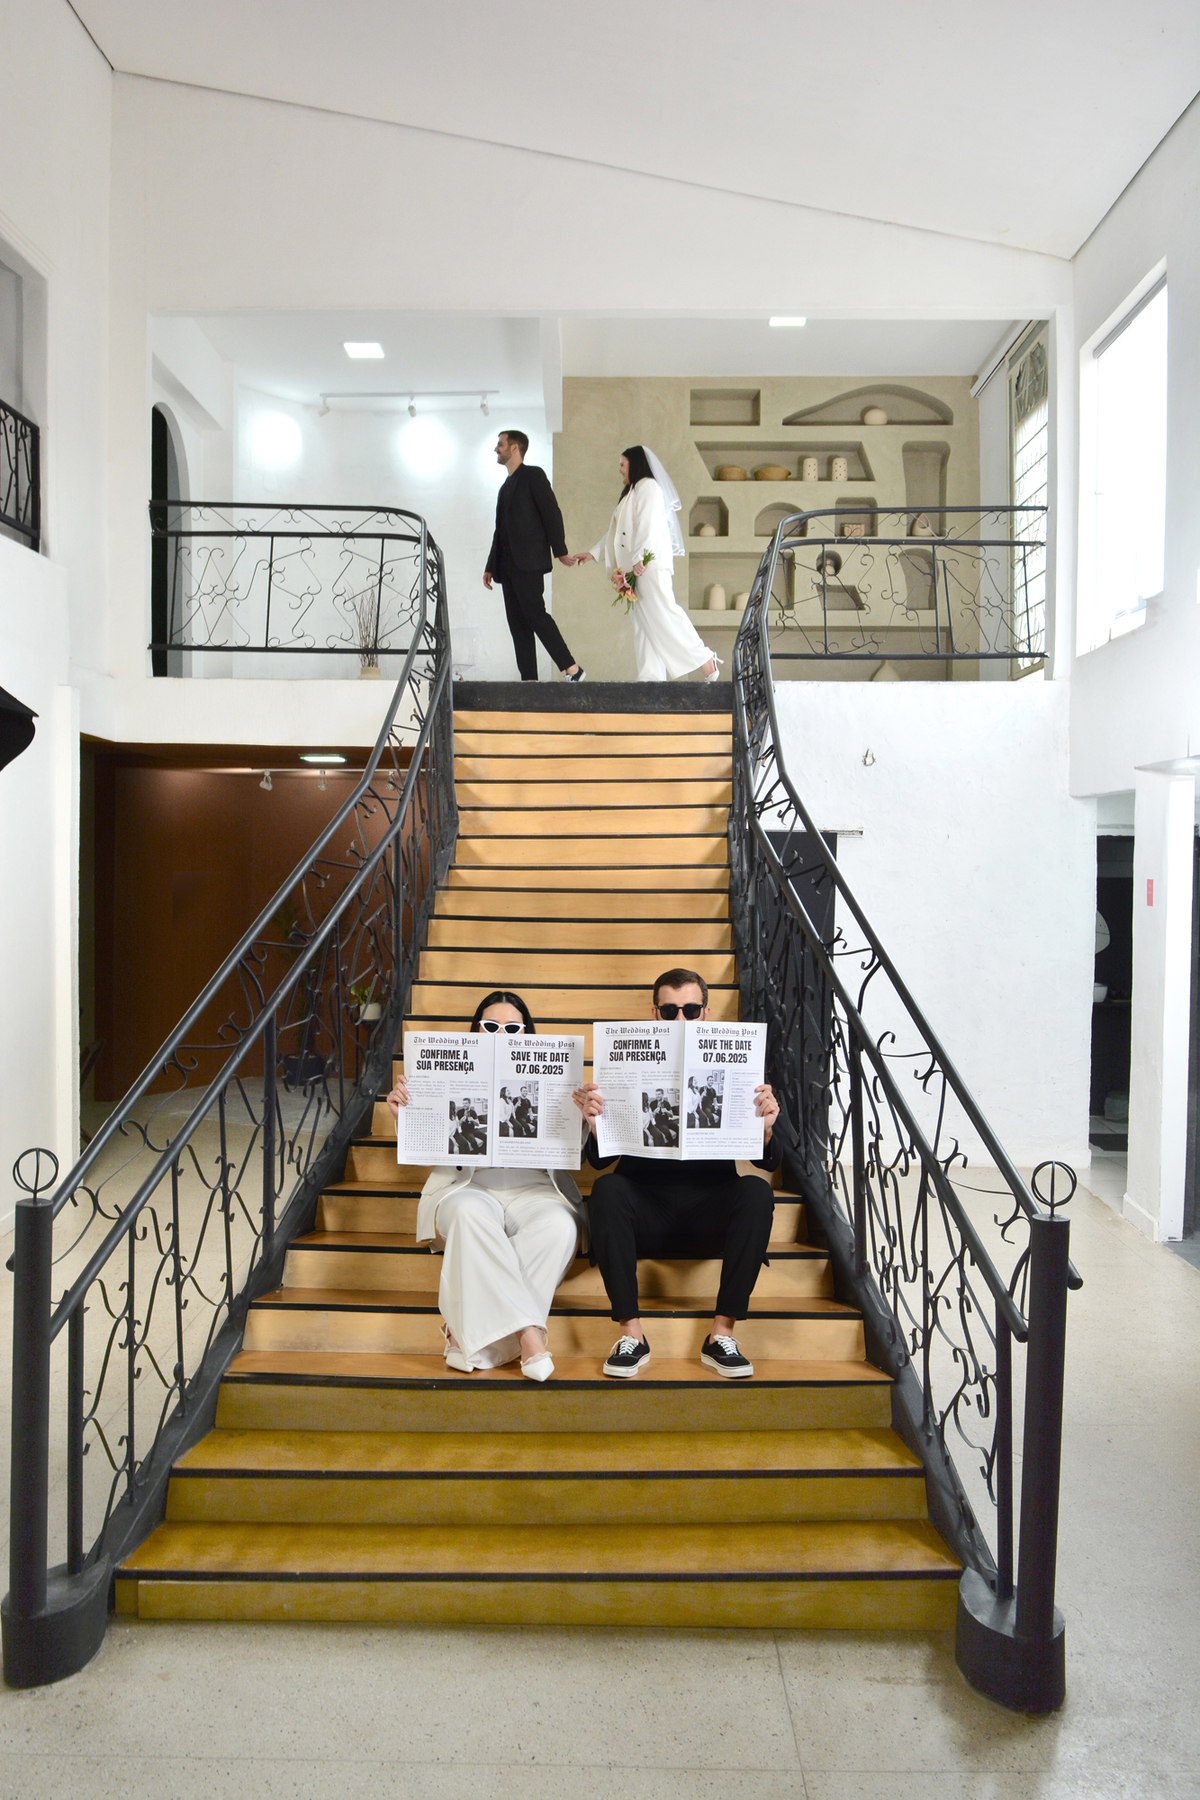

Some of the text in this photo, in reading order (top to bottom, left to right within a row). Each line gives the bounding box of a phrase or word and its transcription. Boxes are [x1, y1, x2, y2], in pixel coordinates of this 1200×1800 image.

[620, 1027, 650, 1035] Wedding
[711, 1027, 740, 1036] Wedding
[742, 1028, 757, 1036] Post
[428, 1037, 459, 1045] Wedding
[525, 1040, 555, 1048] Wedding
[613, 1040, 660, 1050] CONFIRME A
[698, 1039, 752, 1050] SAVE THE DATE
[420, 1049, 468, 1060] CONFIRME A
[511, 1051, 569, 1062] SAVE THE DATE
[609, 1051, 666, 1064] SUA PRESENÇA
[703, 1053, 748, 1063] 07.06.2025
[416, 1060, 474, 1074] SUA PRESENÇA
[516, 1064, 564, 1075] 07.06.2025
